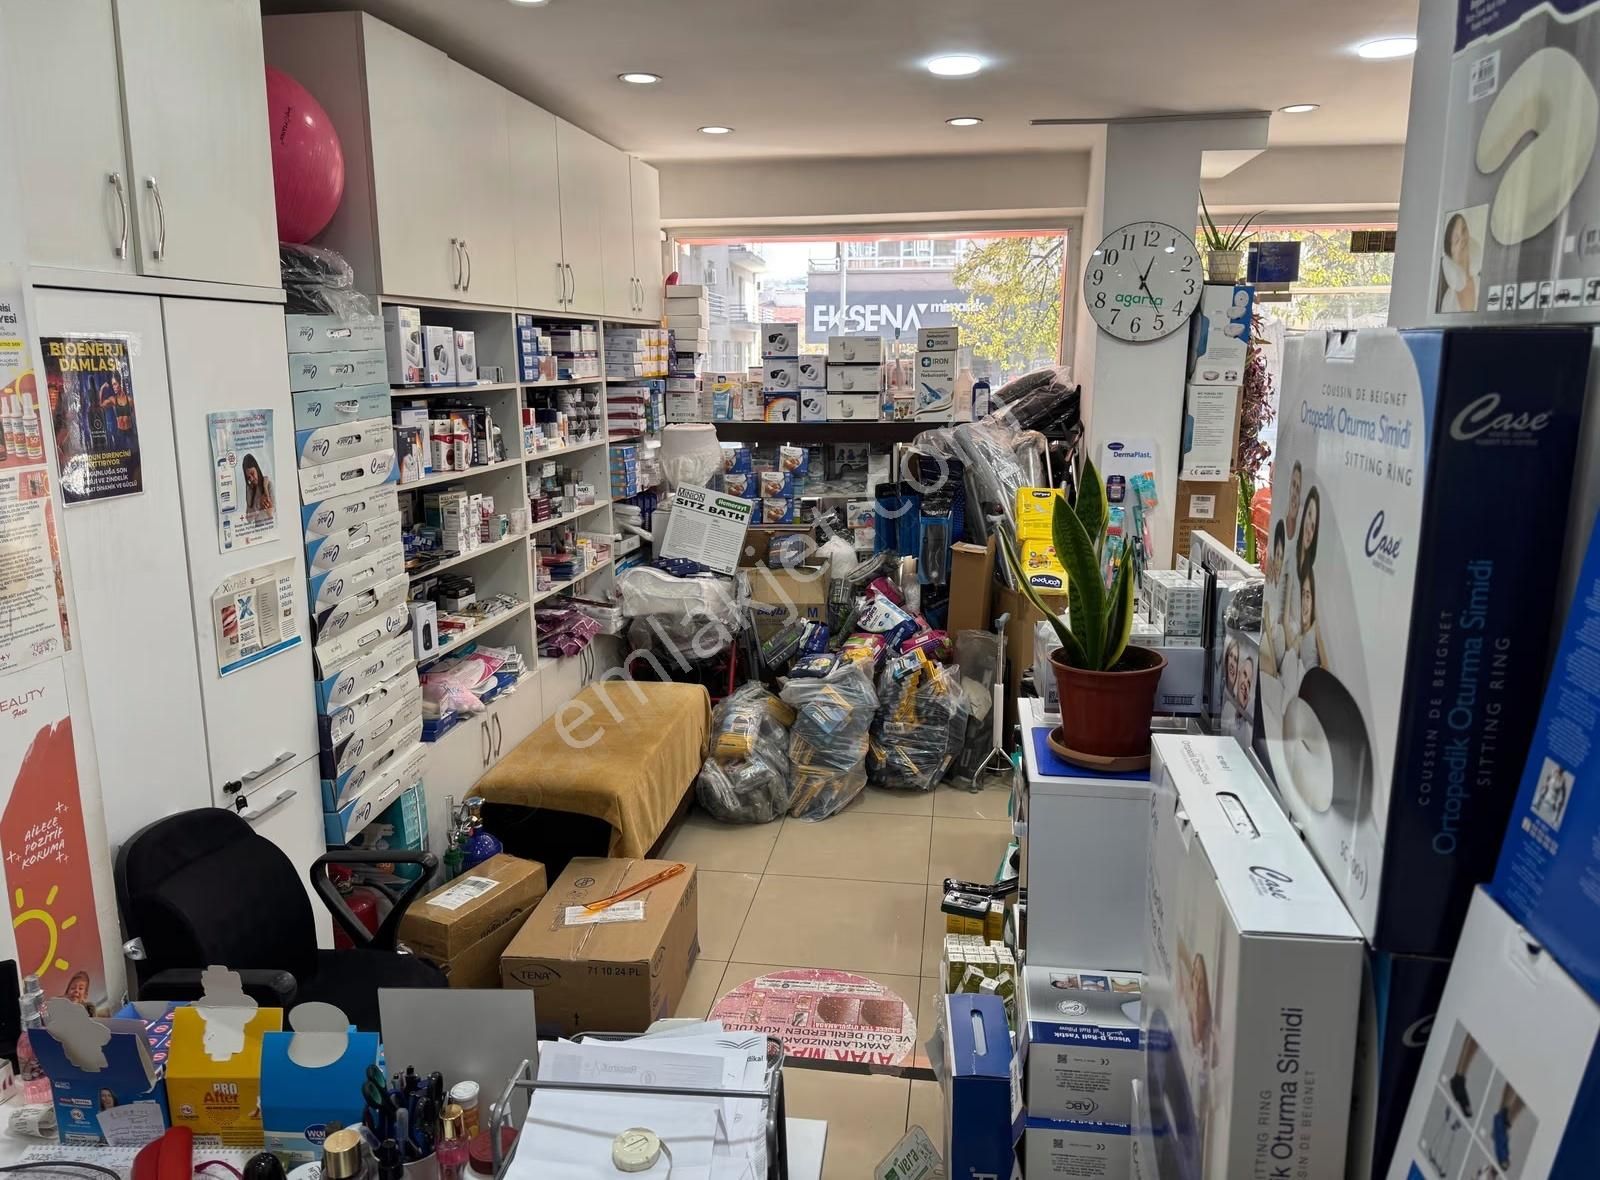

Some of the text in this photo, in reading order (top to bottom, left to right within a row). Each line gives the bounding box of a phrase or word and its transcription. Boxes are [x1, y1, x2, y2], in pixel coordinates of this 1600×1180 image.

[1121, 233, 1136, 251] 11
[1143, 230, 1160, 247] 12
[1102, 249, 1119, 266] 10
[1180, 255, 1193, 272] 2
[1092, 269, 1104, 286] 9
[1183, 279, 1195, 295] 3
[1094, 292, 1106, 308] 8
[1115, 294, 1163, 308] agarta
[1172, 300, 1184, 316] 4
[813, 303, 922, 332] EKSENA
[1110, 308, 1121, 325] 7
[1152, 314, 1165, 330] 5
[1130, 317, 1142, 334] 6
[1321, 384, 1407, 407] COUSSIN DE BEIGNET
[1300, 400, 1412, 450] Ortopedik Oturma Simidi
[1450, 392, 1551, 441] Case
[1344, 450, 1412, 488] SITTING RING
[676, 498, 745, 521] SITZ BATH
[1366, 510, 1400, 558] Case
[807, 608, 818, 618] M
[1418, 610, 1452, 806] COUSSIN DE BEIGNET
[1432, 560, 1494, 855] Ortopedik Oturma Simidi
[1477, 638, 1510, 787] SITTING RING
[22, 840, 66, 870] KORUMA
[520, 970, 550, 980] TENA
[628, 968, 640, 976] PL
[785, 1028, 865, 1040] DERİLERDEN
[866, 1032, 892, 1042] ÖLÜ
[896, 1034, 911, 1043] VE
[1082, 1034, 1106, 1042] D-Roll
[1108, 1035, 1132, 1044] Visco
[213, 1083, 238, 1095] PRO
[1270, 1008, 1304, 1160] Oturma Simidi
[1064, 1102, 1091, 1111] ABC
[1299, 1070, 1316, 1150] DE BEIGNET
[1254, 1090, 1272, 1180] ITTING RING
